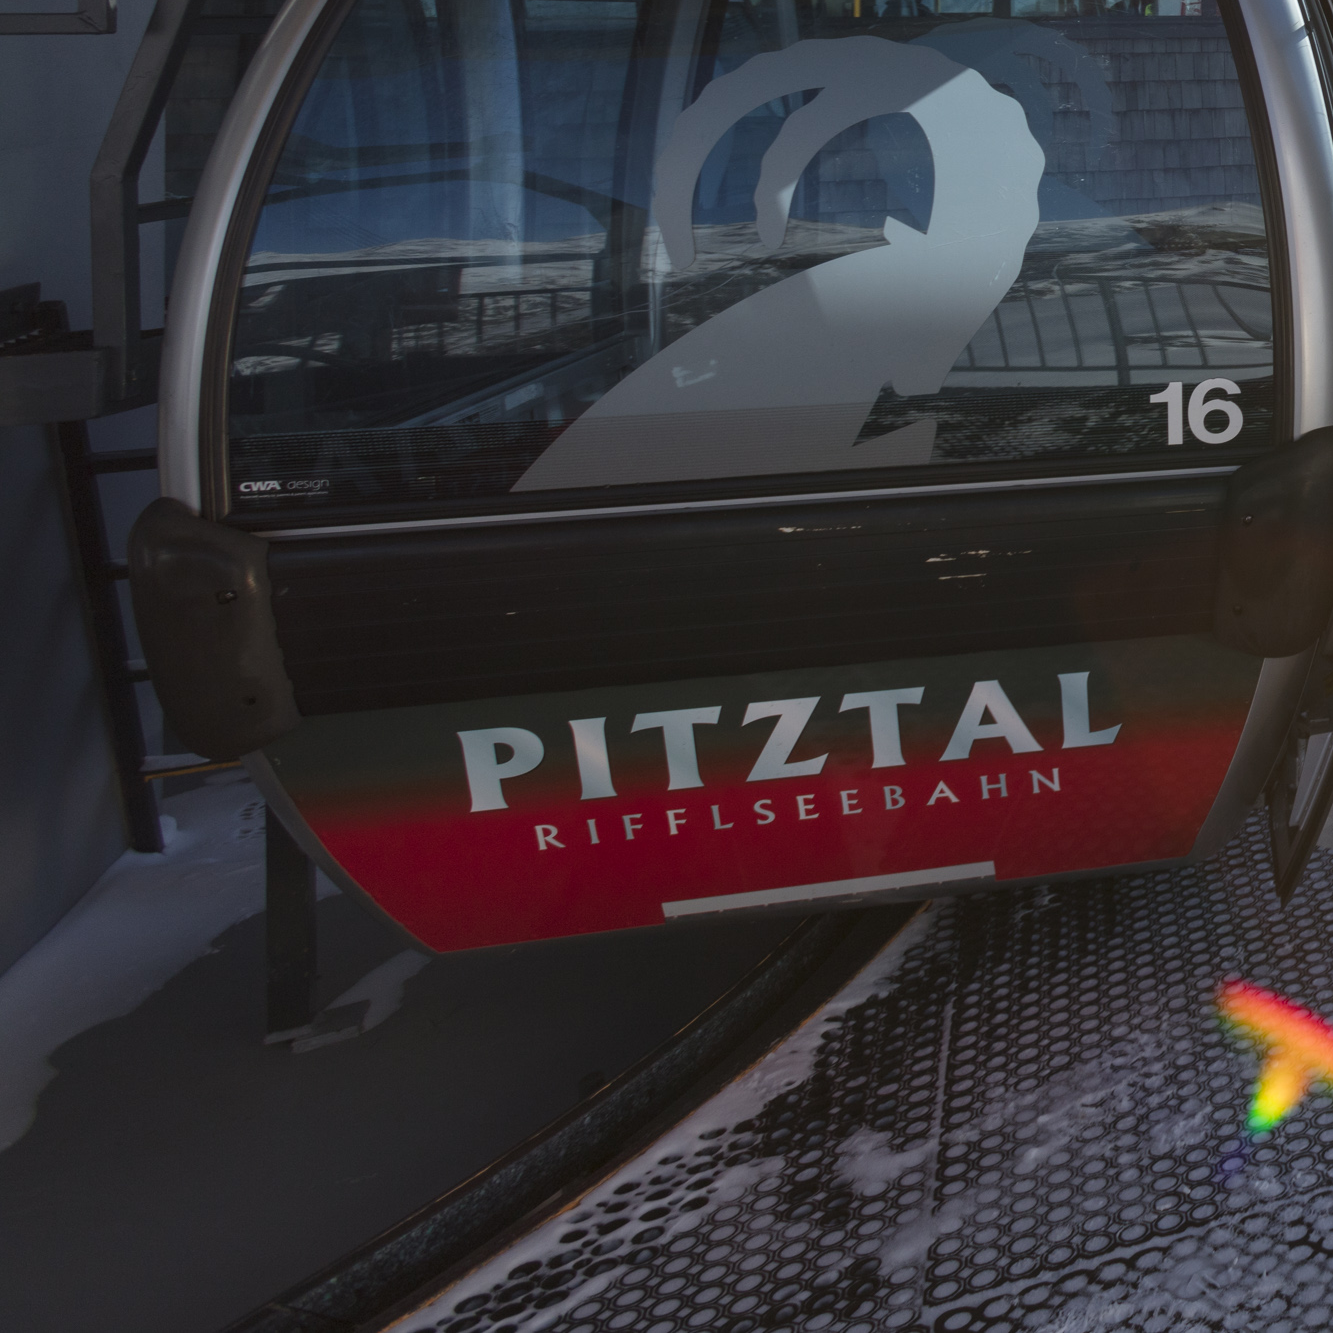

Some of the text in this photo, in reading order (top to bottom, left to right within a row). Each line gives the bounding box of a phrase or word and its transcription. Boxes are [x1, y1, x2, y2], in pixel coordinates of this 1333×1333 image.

[1149, 377, 1244, 446] 16
[239, 479, 330, 491] CWA design
[456, 670, 1124, 814] PITZTAL
[534, 766, 1063, 852] RIFFLSEEBAHN
